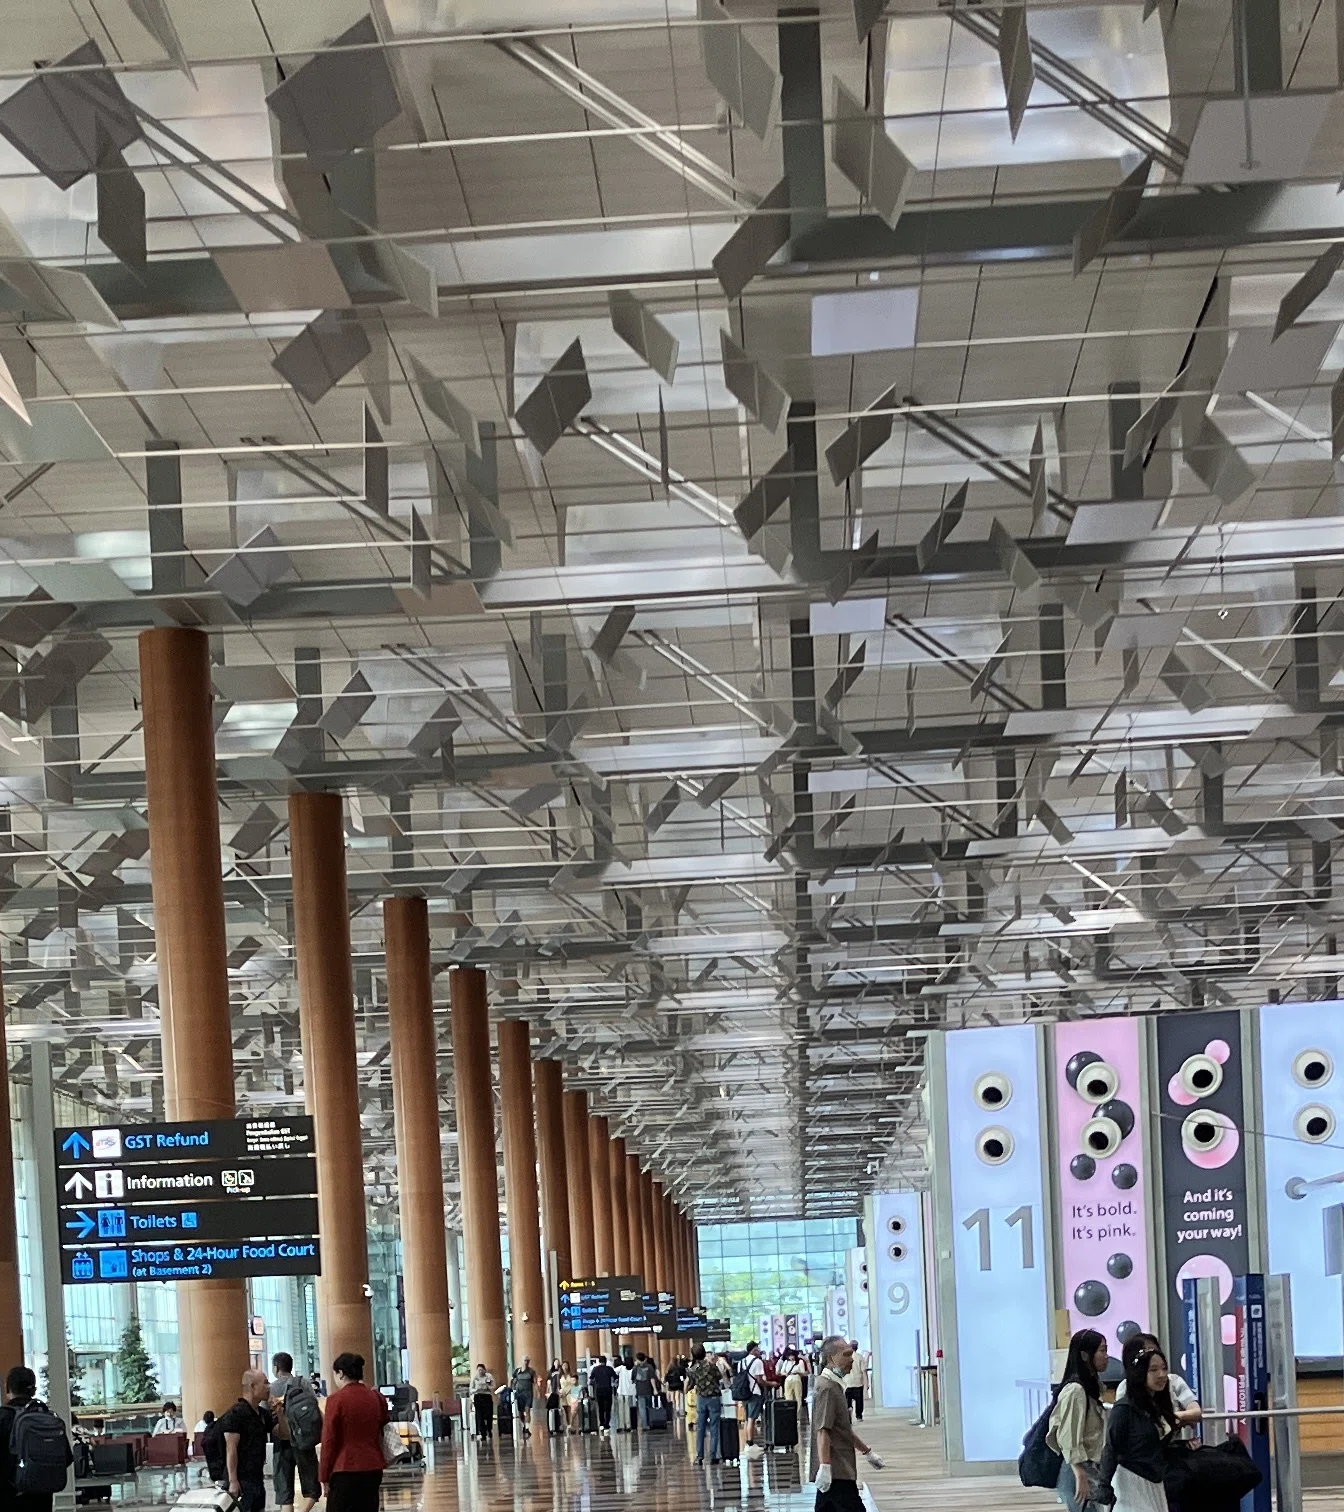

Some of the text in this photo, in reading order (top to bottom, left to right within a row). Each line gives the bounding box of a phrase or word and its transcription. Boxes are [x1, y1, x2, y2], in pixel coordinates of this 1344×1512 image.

[124, 1131, 209, 1149] GST Refund
[127, 1173, 213, 1190] Information
[1183, 1188, 1233, 1203] And it's
[1072, 1201, 1137, 1218] It's bold.
[1183, 1207, 1234, 1223] coming
[130, 1215, 177, 1229] Toilets
[962, 1205, 1035, 1271] 11
[1072, 1223, 1136, 1241] It's pink.
[1177, 1224, 1242, 1243] your way!
[131, 1243, 315, 1265] Shops & 24-Hour Food Court
[132, 1264, 212, 1277] (at Basement 2)
[887, 1282, 910, 1315] 9
[1238, 1374, 1247, 1425] PRIORIY
